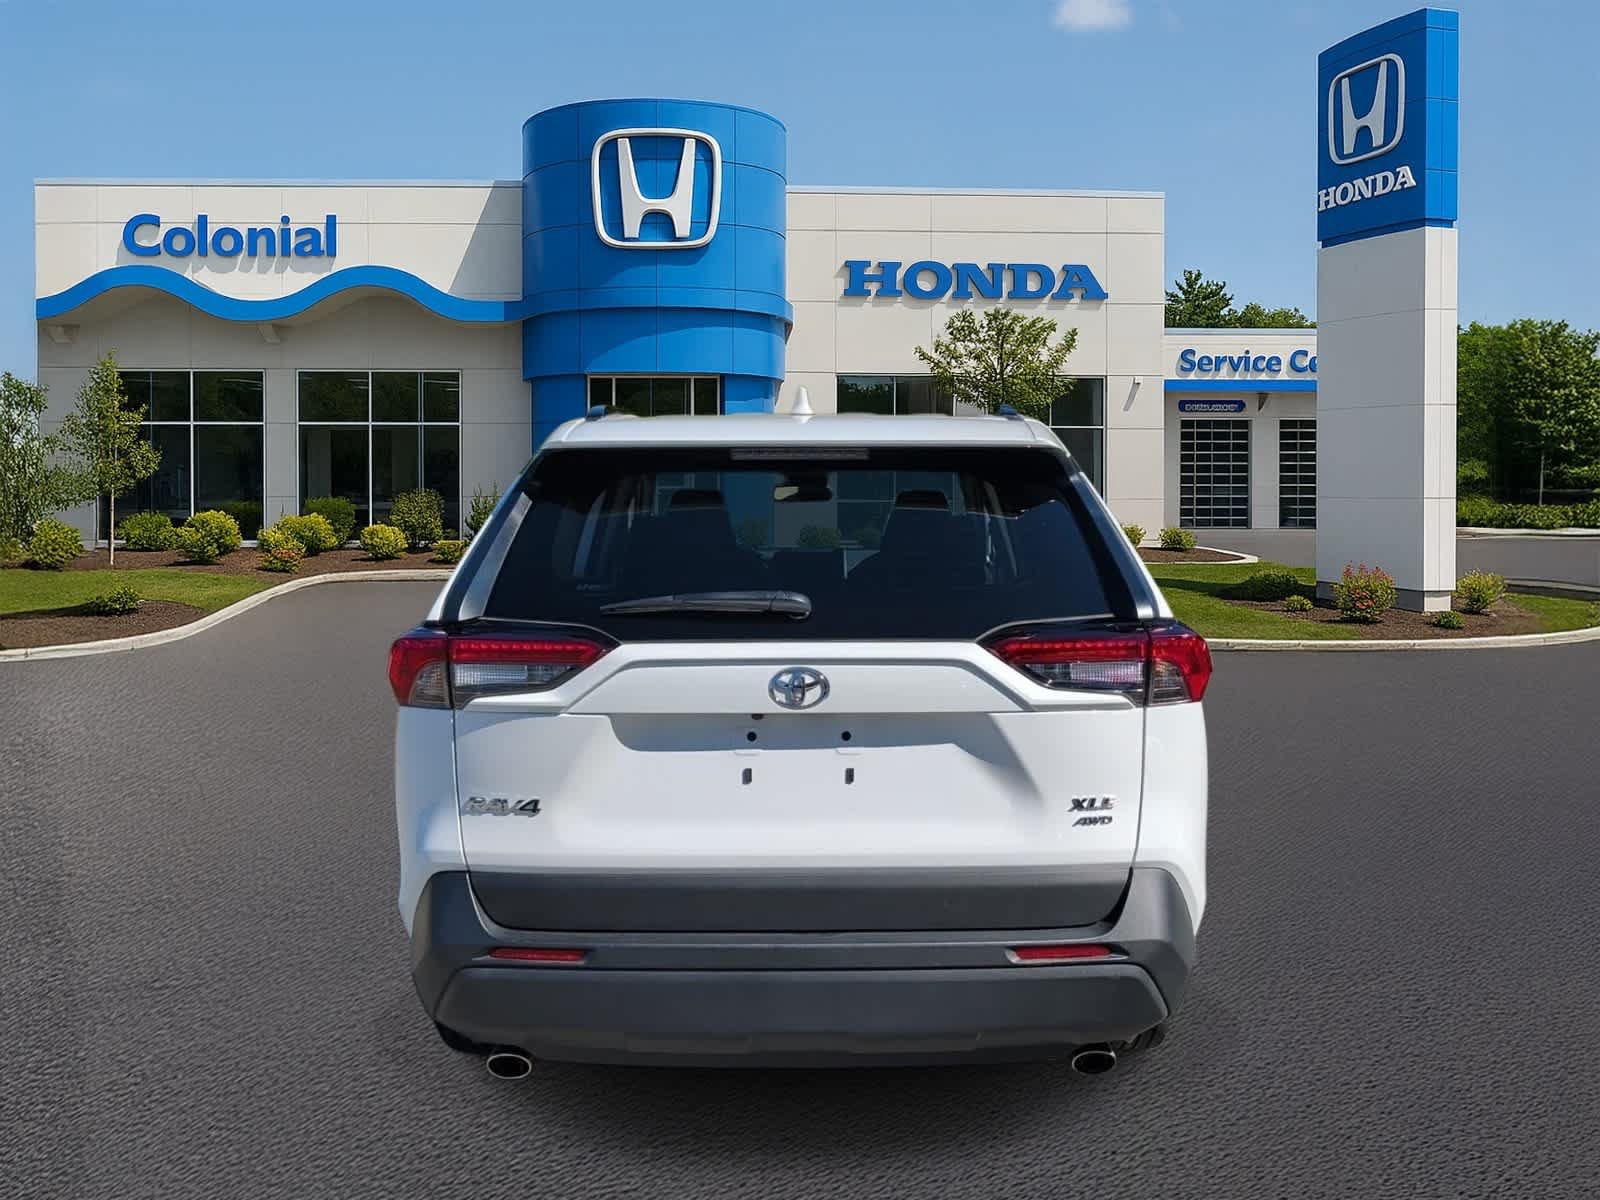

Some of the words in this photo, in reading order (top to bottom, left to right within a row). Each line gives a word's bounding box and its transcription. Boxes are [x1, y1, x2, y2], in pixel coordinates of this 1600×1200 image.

[1318, 165, 1417, 212] HONDA
[122, 213, 337, 258] Colonial
[843, 260, 1109, 300] HONDA
[1179, 348, 1282, 373] Service
[1067, 797, 1113, 812] XLE
[1071, 816, 1113, 827] AWD
